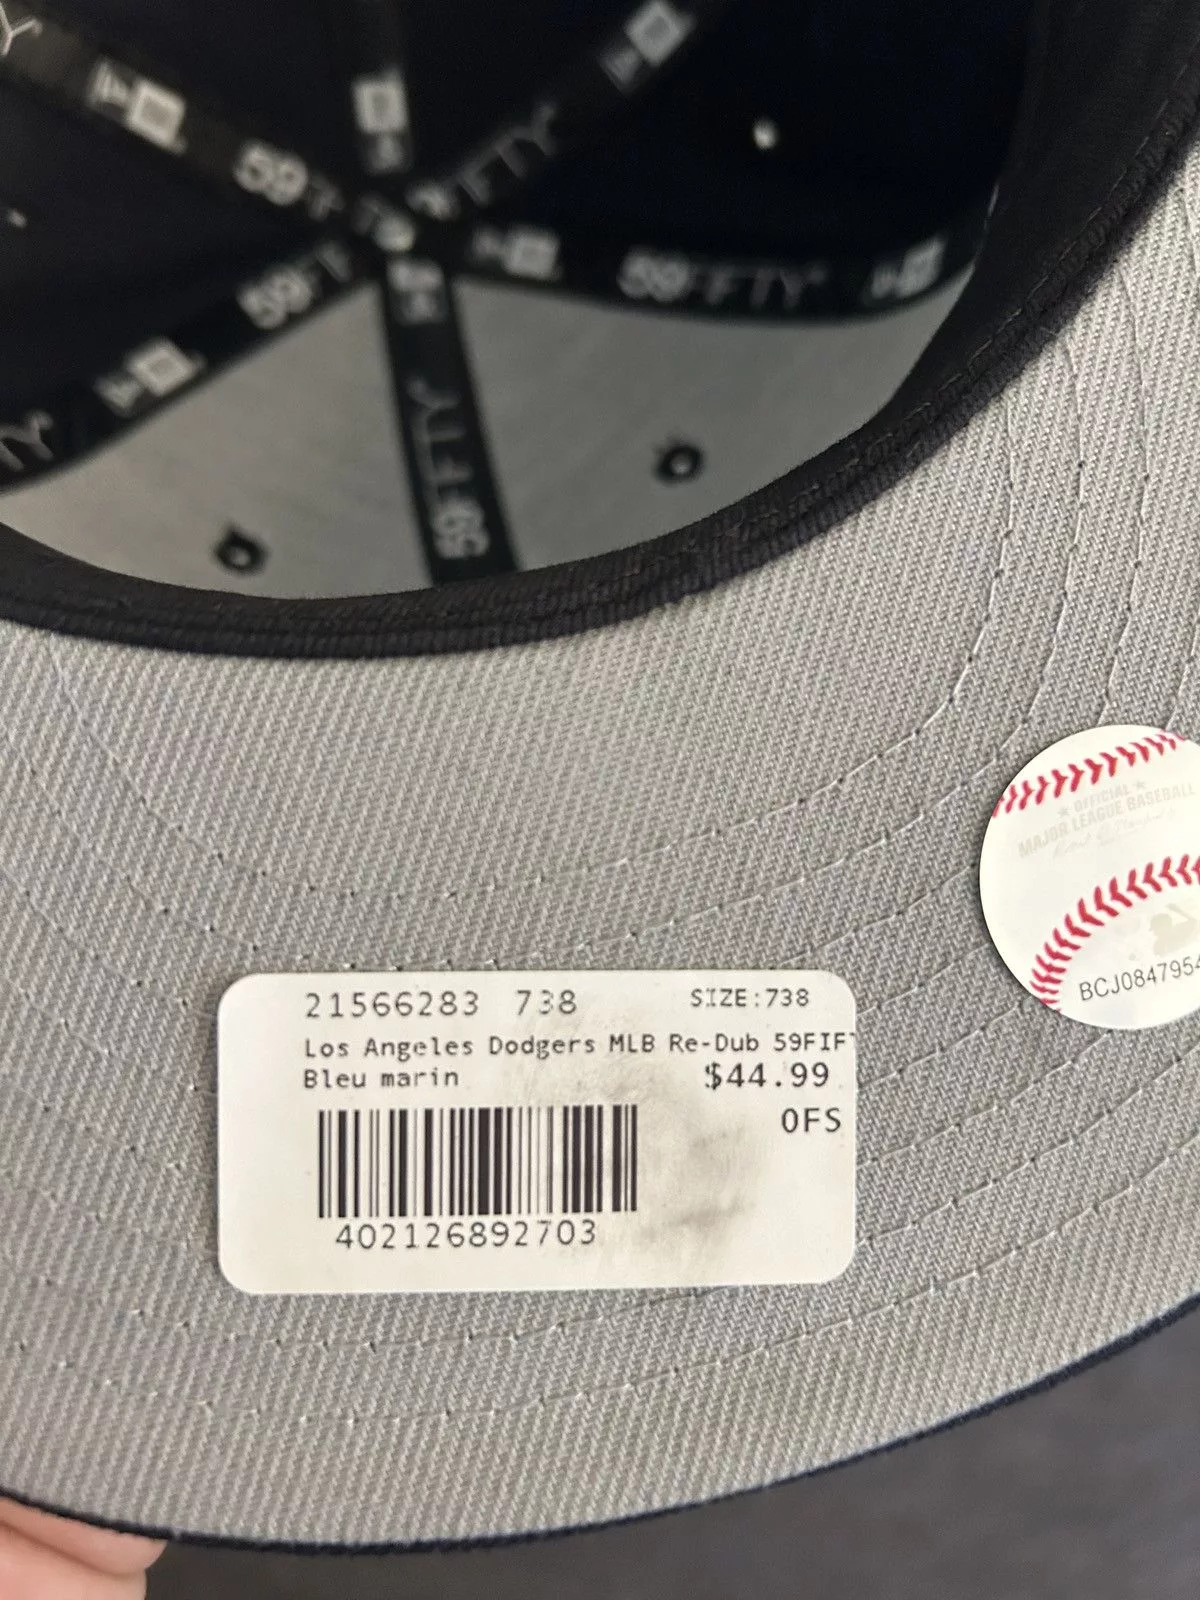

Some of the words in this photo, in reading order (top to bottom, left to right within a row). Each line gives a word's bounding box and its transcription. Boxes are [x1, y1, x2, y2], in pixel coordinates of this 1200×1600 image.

[1073, 783, 1131, 813] OFFICIAL
[1017, 820, 1070, 858] MAJOR
[1071, 799, 1125, 831] LEAGUE
[1127, 782, 1197, 812] BASEBALL
[305, 990, 479, 1018] 21566283
[516, 989, 578, 1015] 738
[690, 987, 810, 1008] SIZE:738
[305, 1038, 349, 1058] Los
[364, 1036, 473, 1062] Angeles
[489, 1035, 595, 1060] Dodgers
[609, 1034, 655, 1053] MLB
[669, 1033, 760, 1053] Re-Dub
[304, 1068, 366, 1089] Bleu
[381, 1068, 459, 1087] marin
[704, 1061, 829, 1091] $44.99
[336, 1221, 597, 1250] 402126892703
